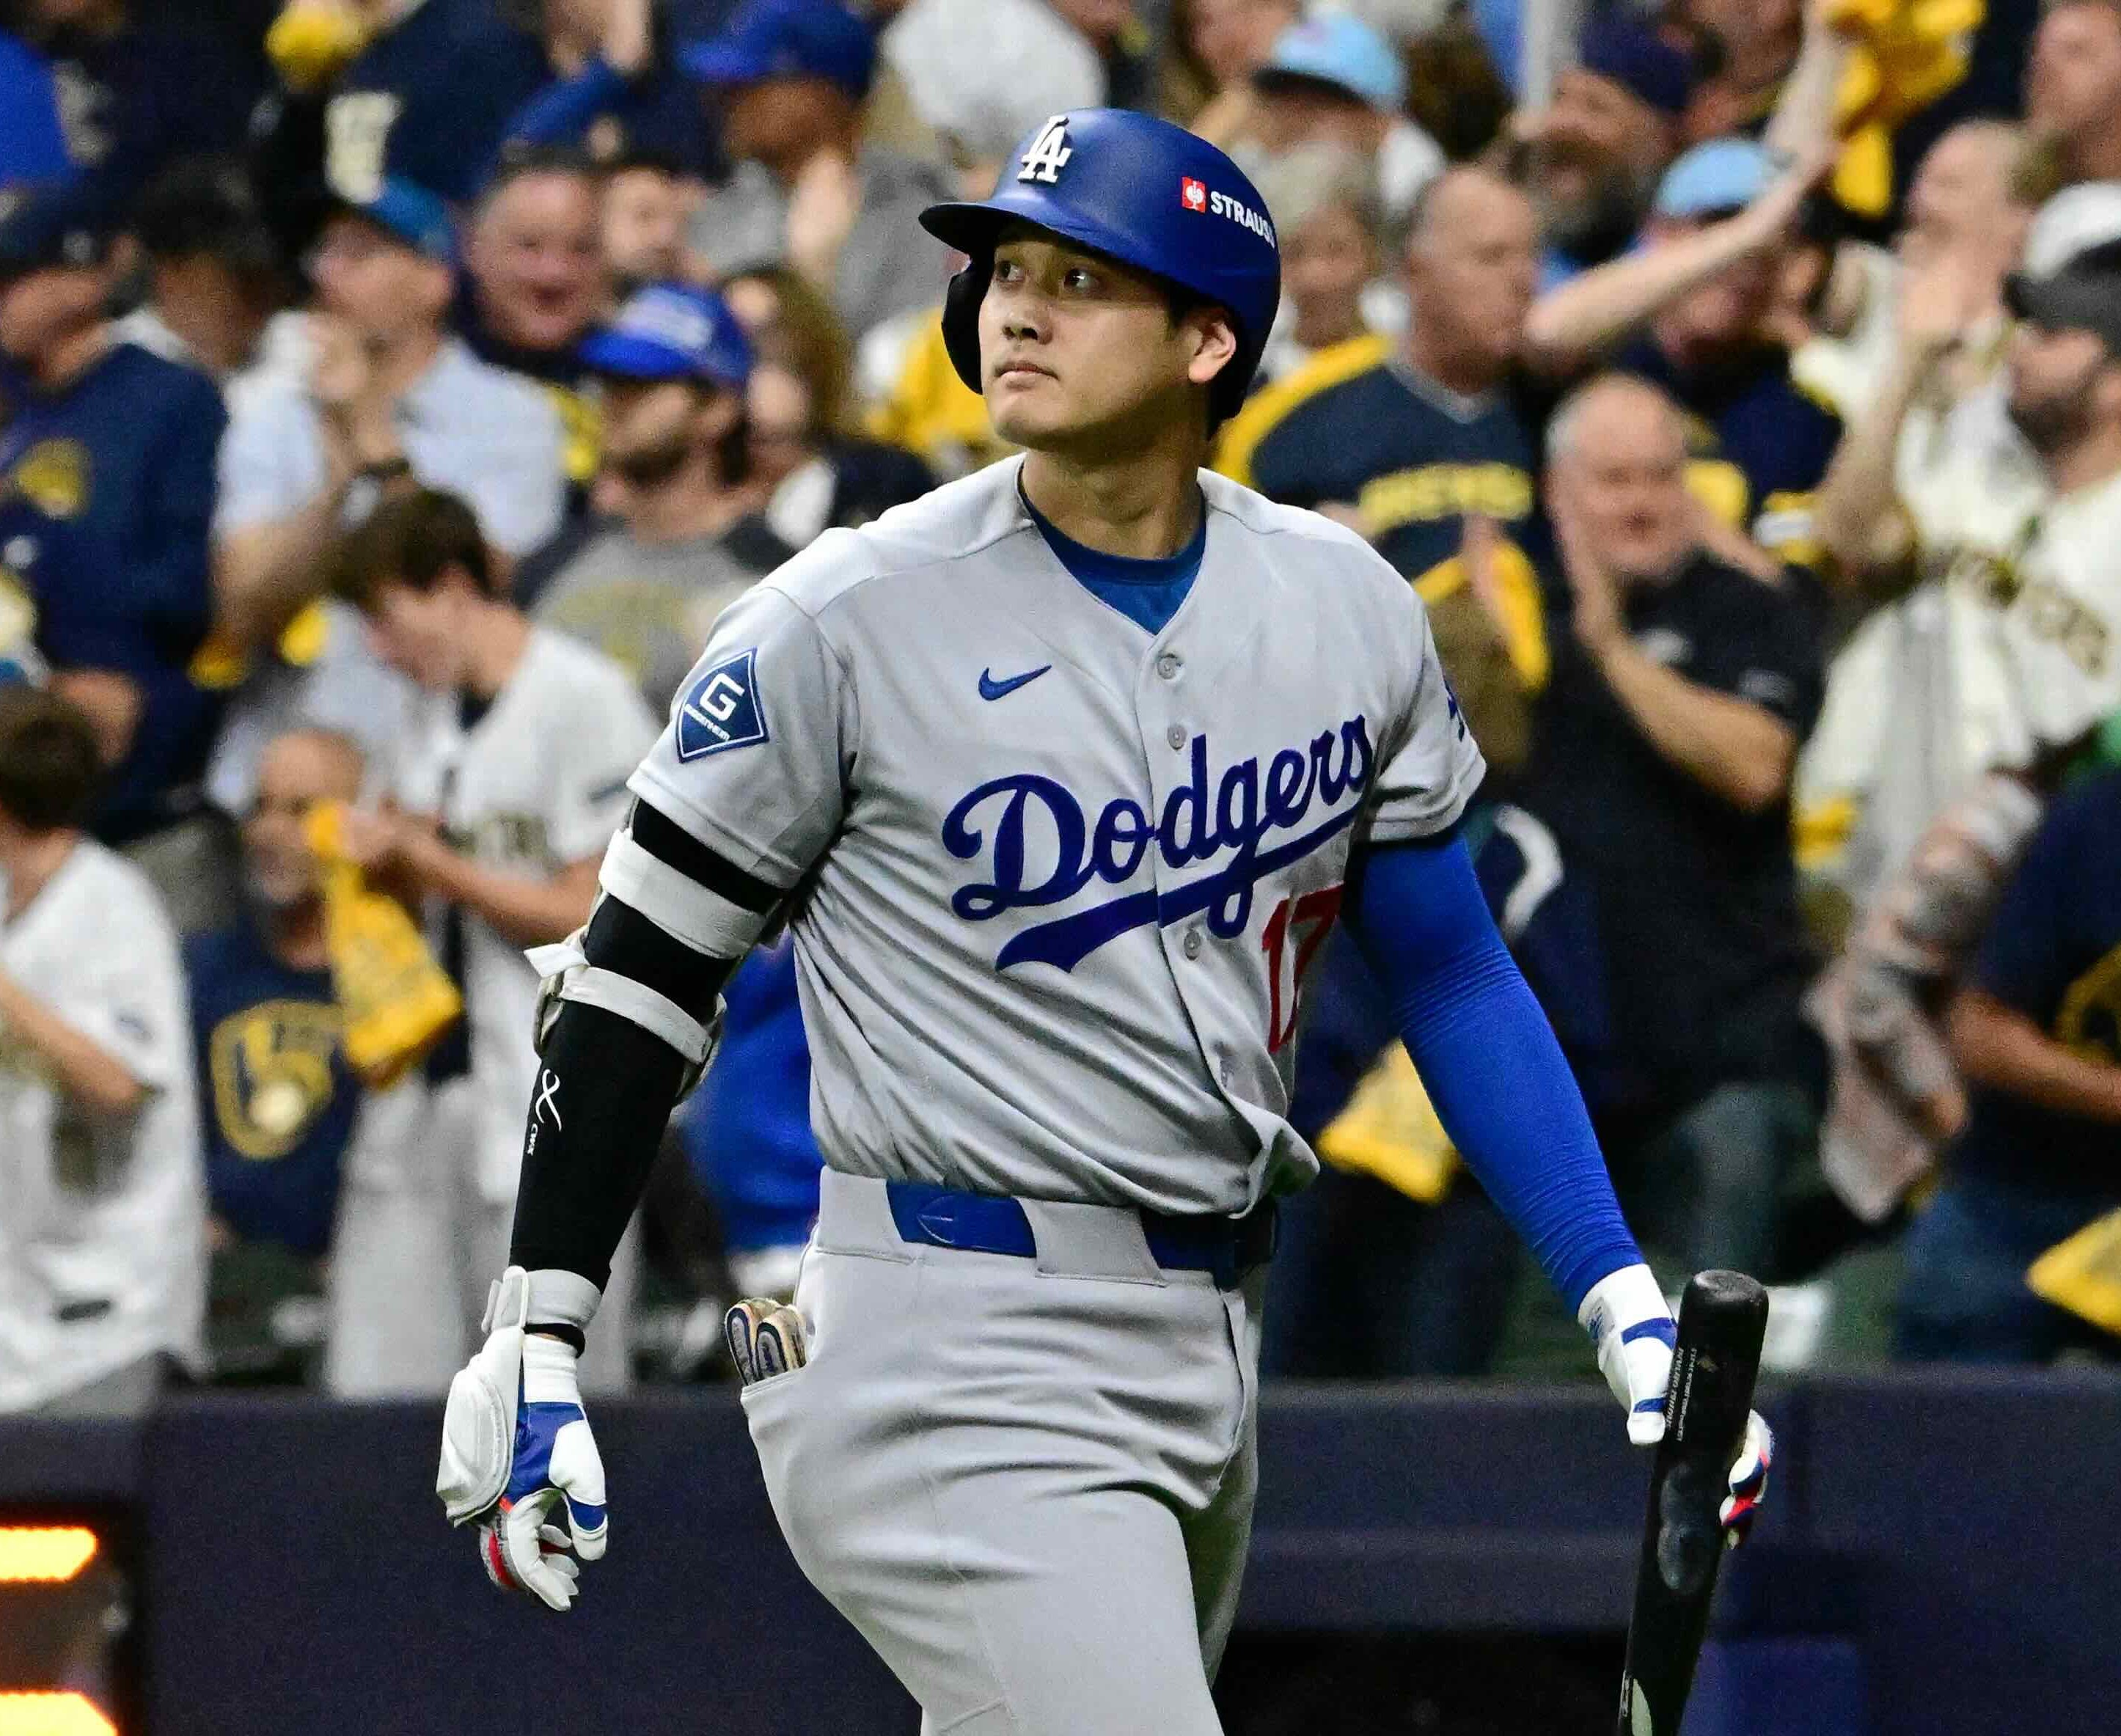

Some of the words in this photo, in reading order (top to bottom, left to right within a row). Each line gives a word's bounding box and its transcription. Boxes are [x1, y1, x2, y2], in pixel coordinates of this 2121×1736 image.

[1017, 115, 1072, 183] LA
[942, 714, 1374, 942] Dodgers
[1262, 883, 1345, 1053] 17
